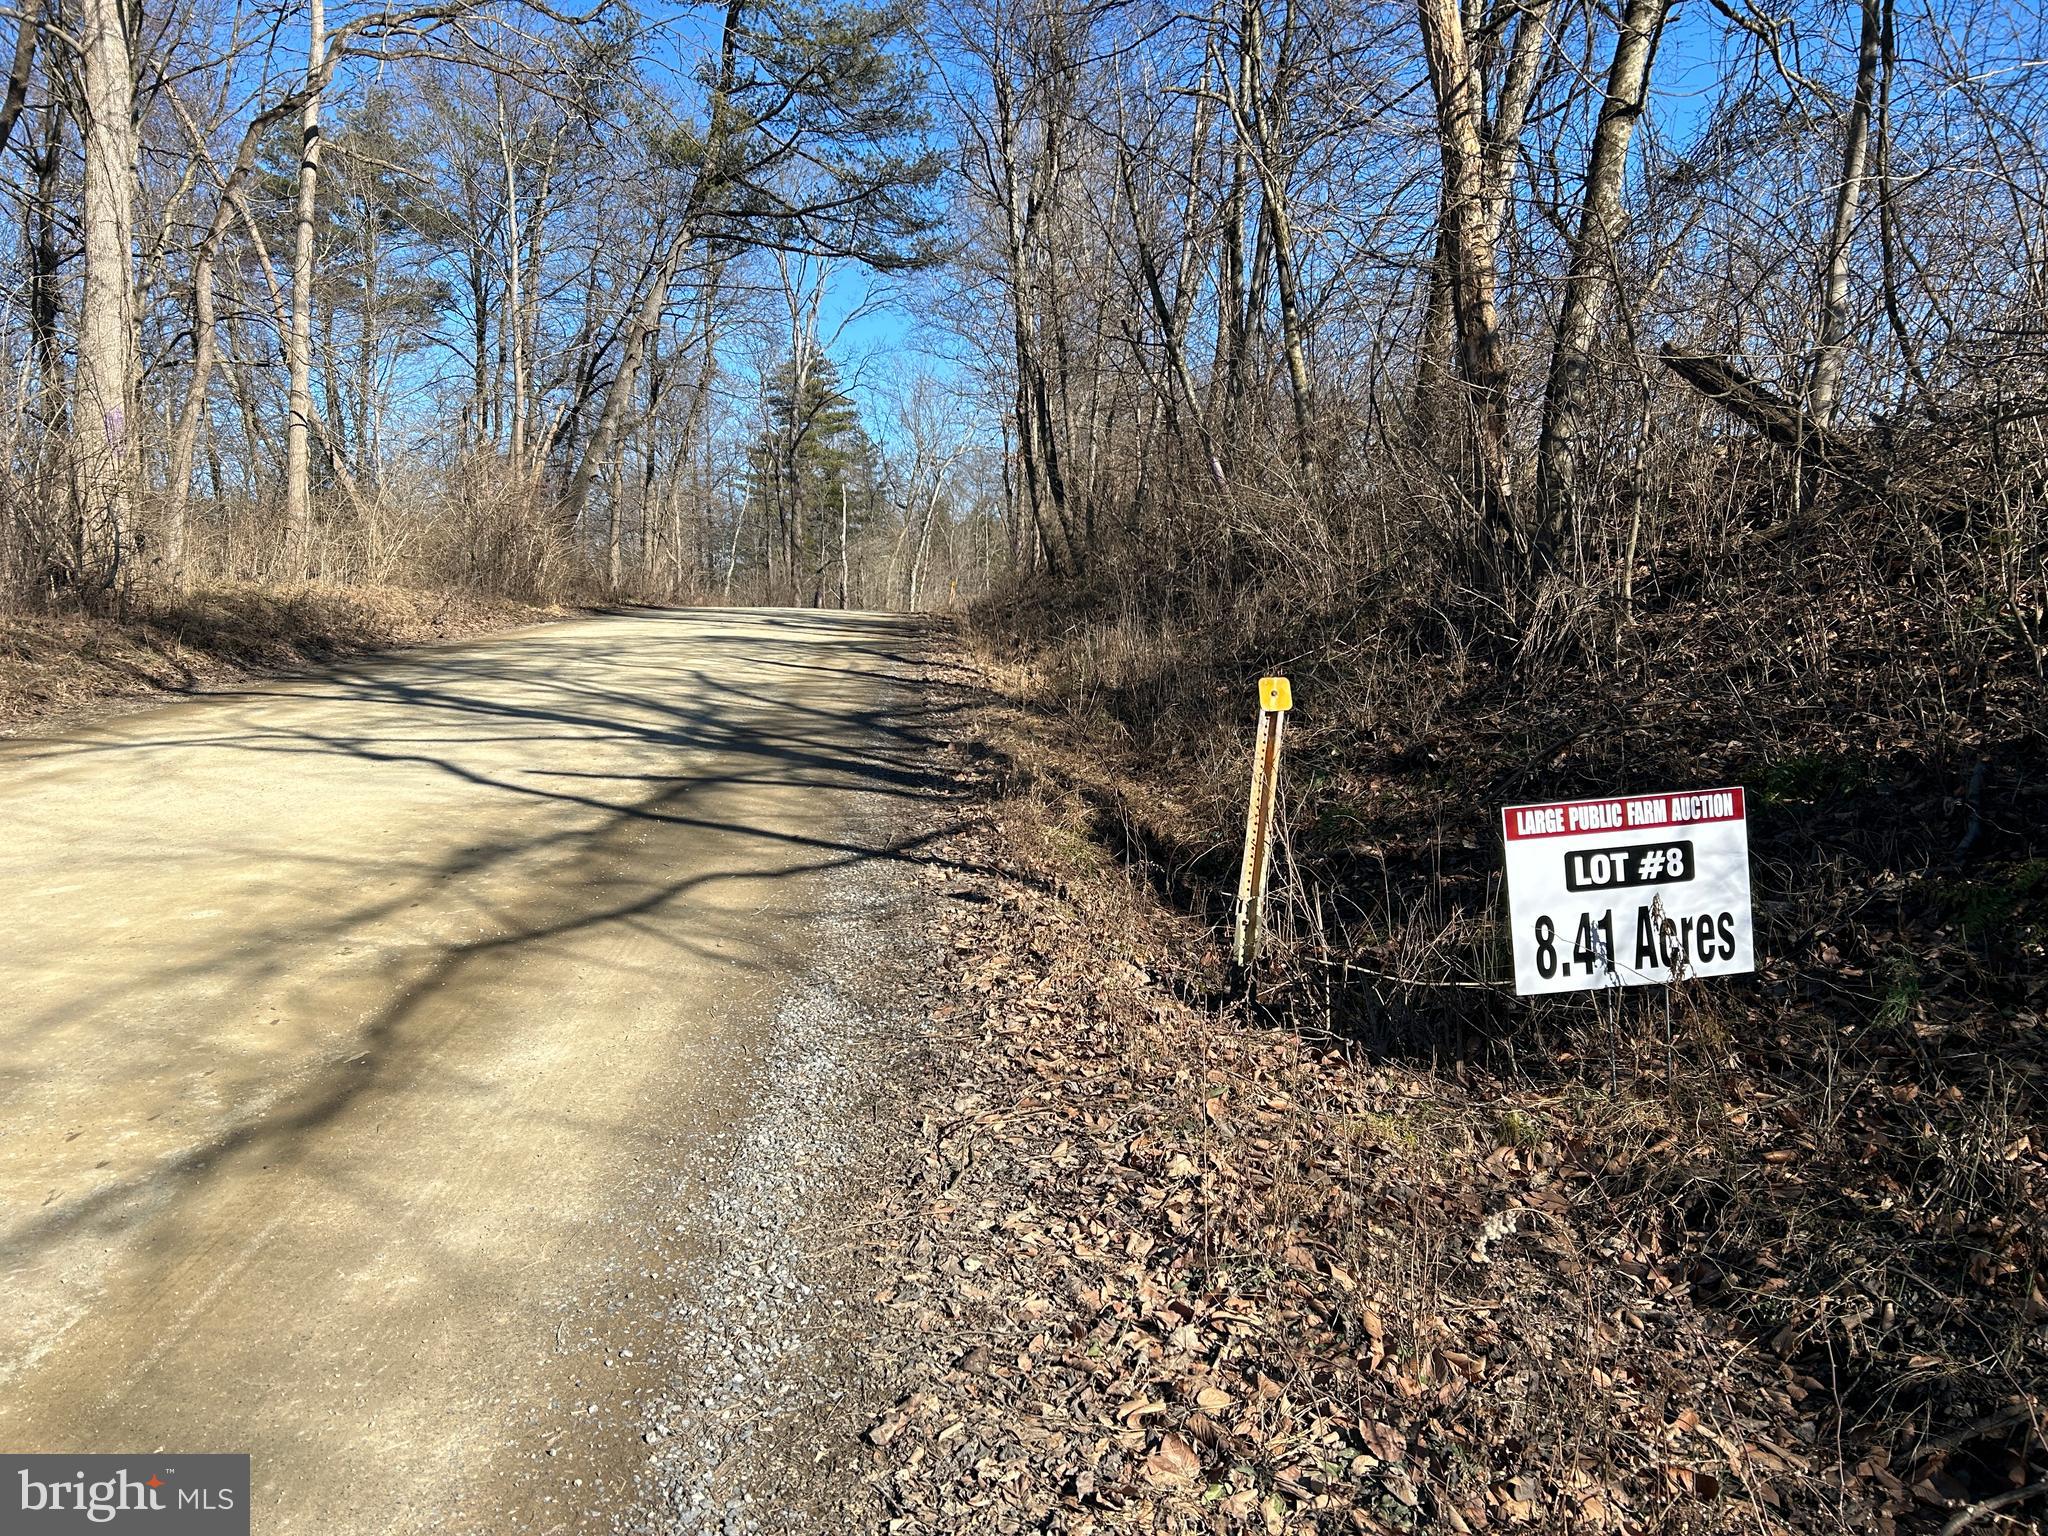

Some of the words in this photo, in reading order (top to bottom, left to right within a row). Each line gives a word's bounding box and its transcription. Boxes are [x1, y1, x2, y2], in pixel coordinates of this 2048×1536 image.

[1516, 807, 1566, 836] LARGE
[1569, 802, 1623, 831] PUBLIC
[1626, 798, 1668, 827] FARM
[1671, 792, 1734, 822] AUCTION
[1573, 852, 1629, 886] LOT
[1638, 847, 1685, 880] #8
[1534, 908, 1616, 980] 8.41
[1635, 905, 1736, 971] Acres
